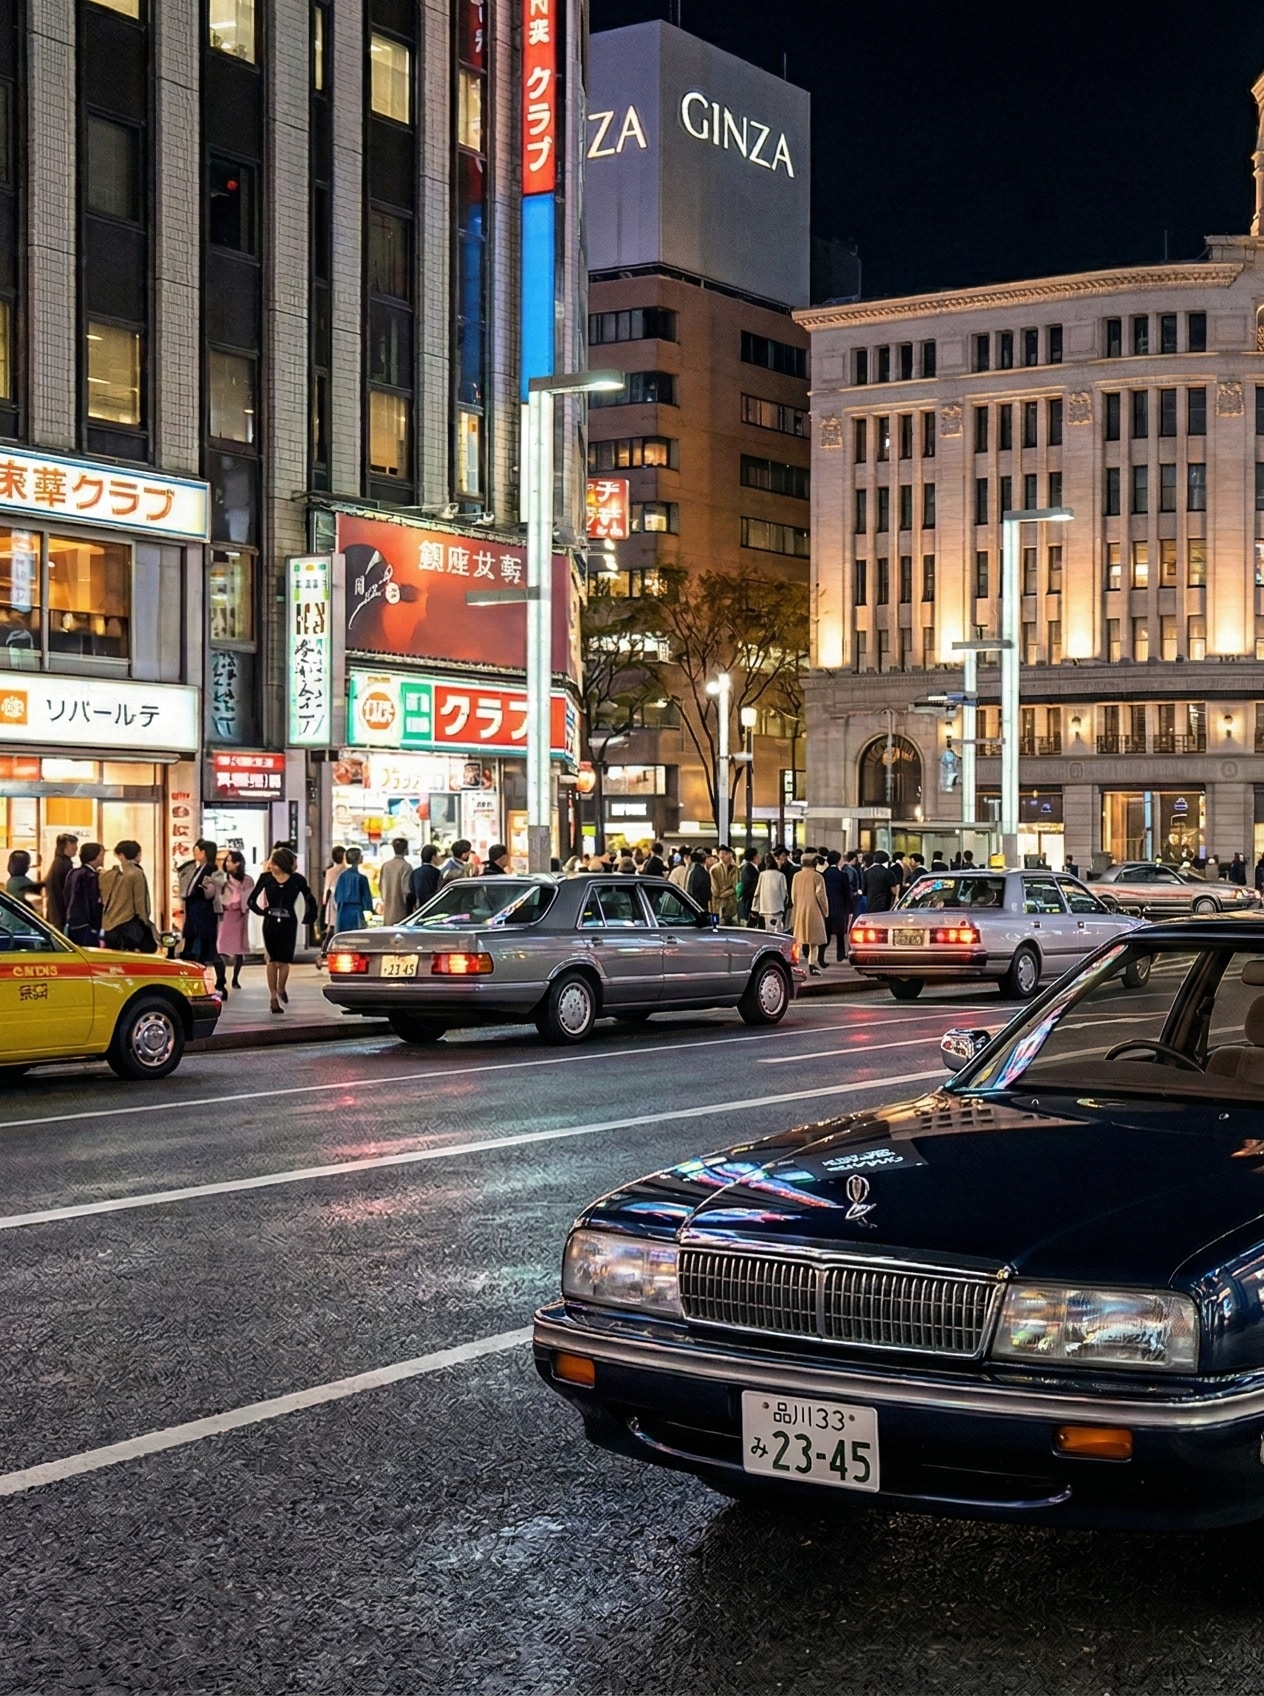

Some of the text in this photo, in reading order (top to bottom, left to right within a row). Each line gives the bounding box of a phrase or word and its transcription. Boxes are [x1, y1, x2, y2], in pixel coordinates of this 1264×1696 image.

[526, 66, 553, 172] クラブ
[587, 104, 648, 159] ZA
[681, 91, 795, 179] GINZA
[750, 1430, 871, 1483] み 23-45
